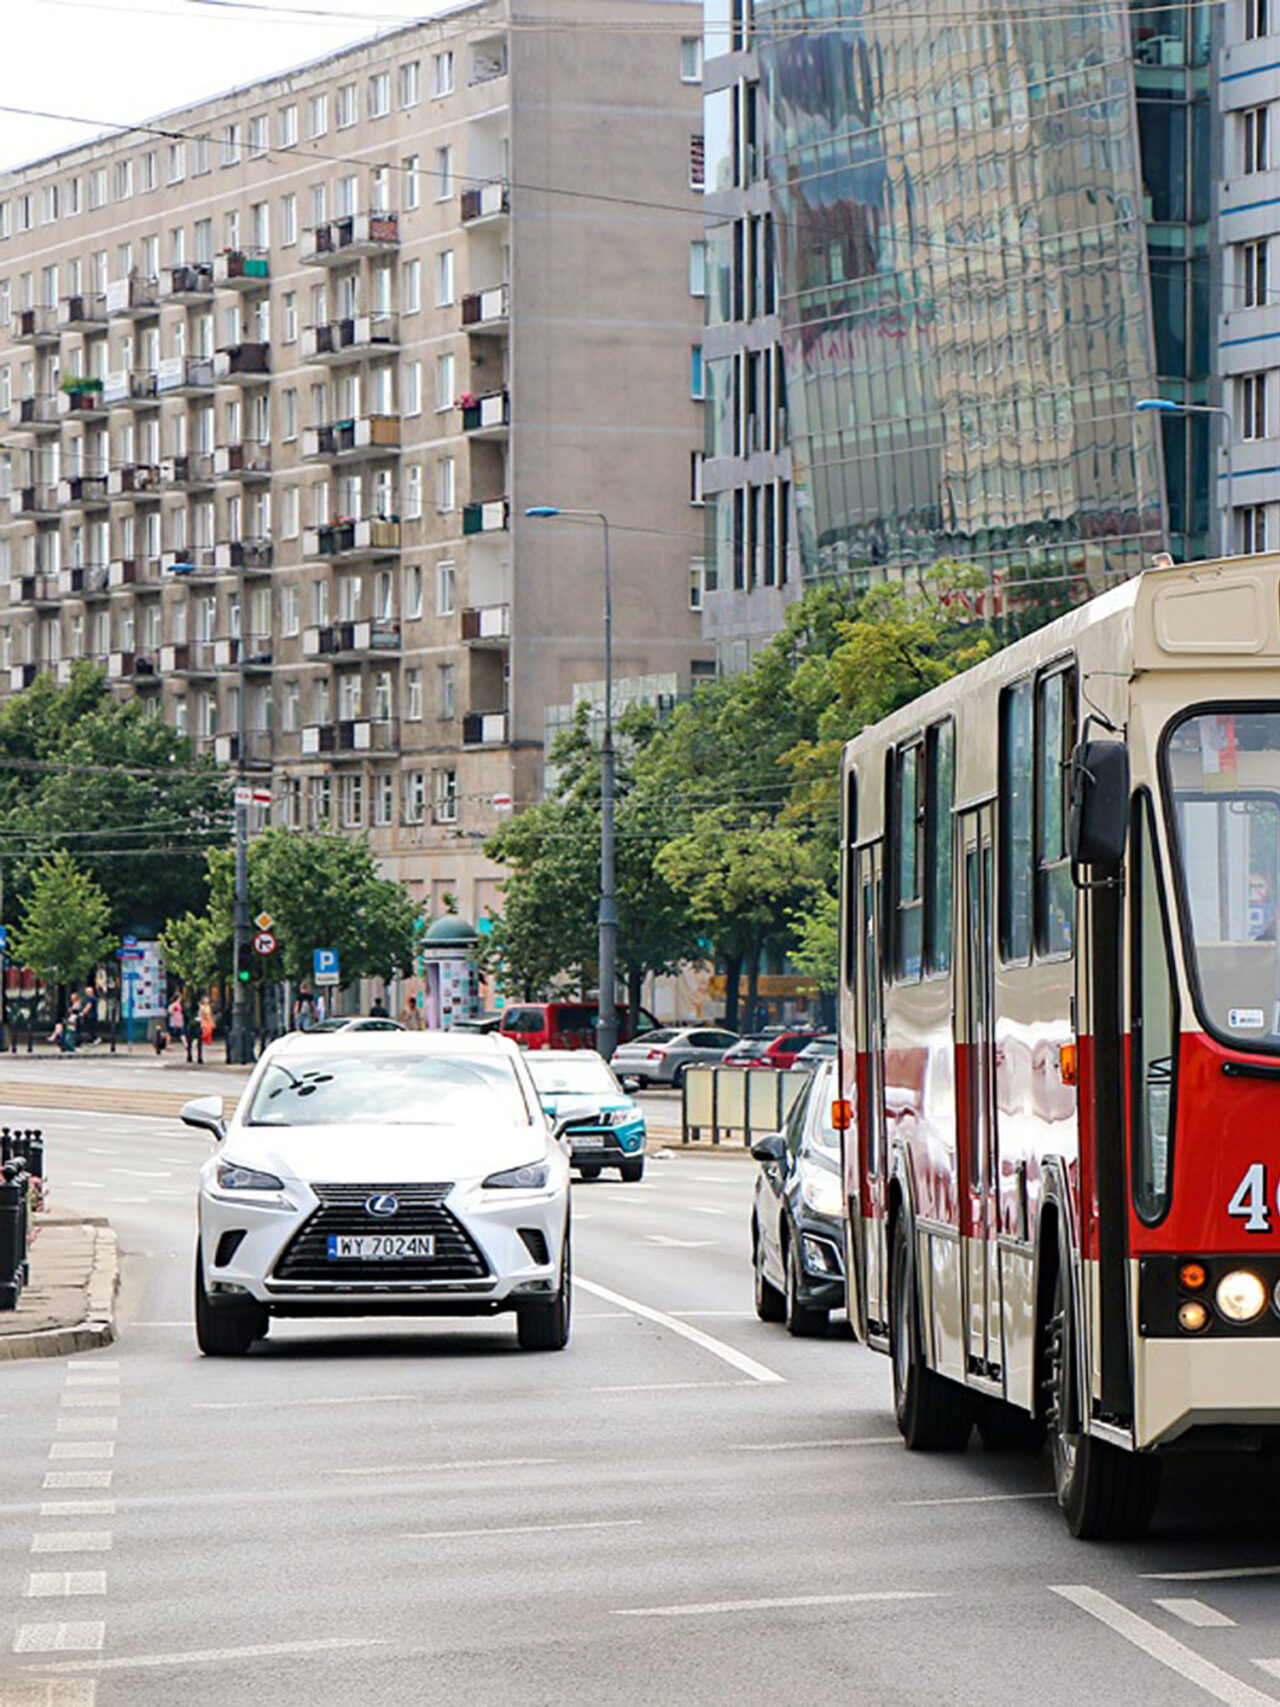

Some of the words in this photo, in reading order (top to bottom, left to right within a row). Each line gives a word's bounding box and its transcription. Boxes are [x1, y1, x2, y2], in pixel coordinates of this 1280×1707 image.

[320, 951, 334, 970] P
[341, 1238, 364, 1254] WY
[372, 1237, 430, 1255] 7024N
